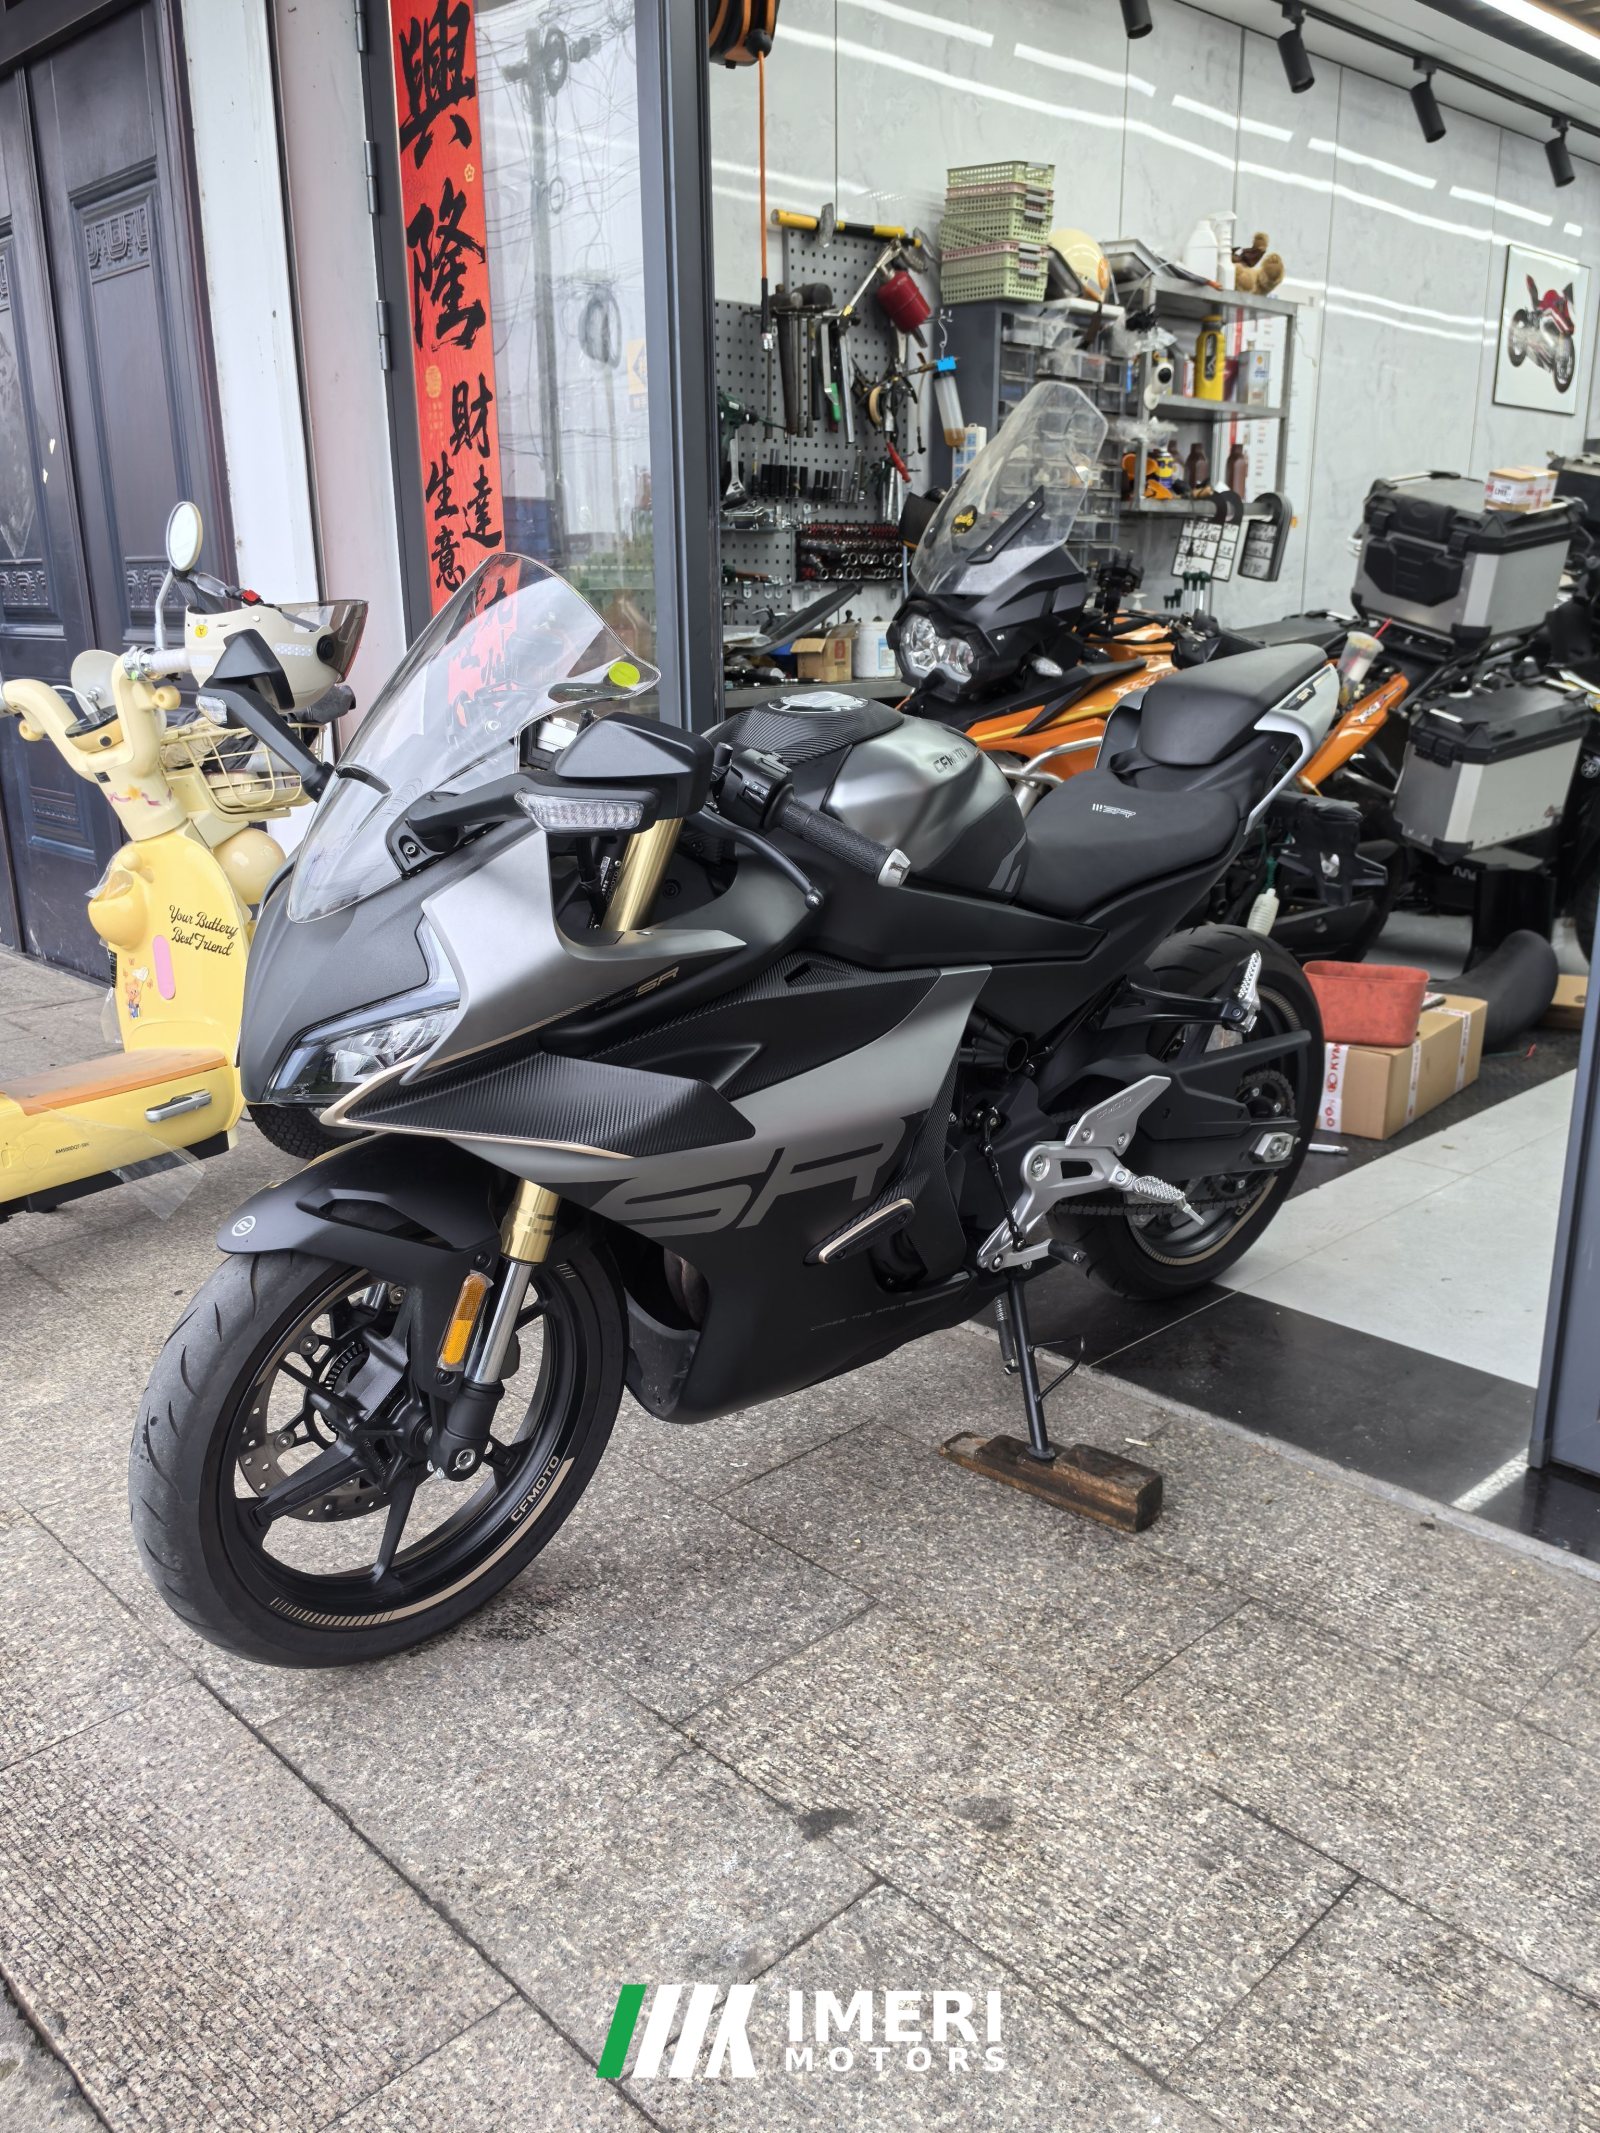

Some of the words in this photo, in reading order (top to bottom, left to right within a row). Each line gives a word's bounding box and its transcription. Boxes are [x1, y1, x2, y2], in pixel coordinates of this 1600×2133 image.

[169, 905, 193, 924] Your
[195, 911, 239, 939] Buttery
[171, 926, 194, 946] Best
[194, 932, 234, 956] Friend
[510, 1455, 560, 1522] CFMOTO
